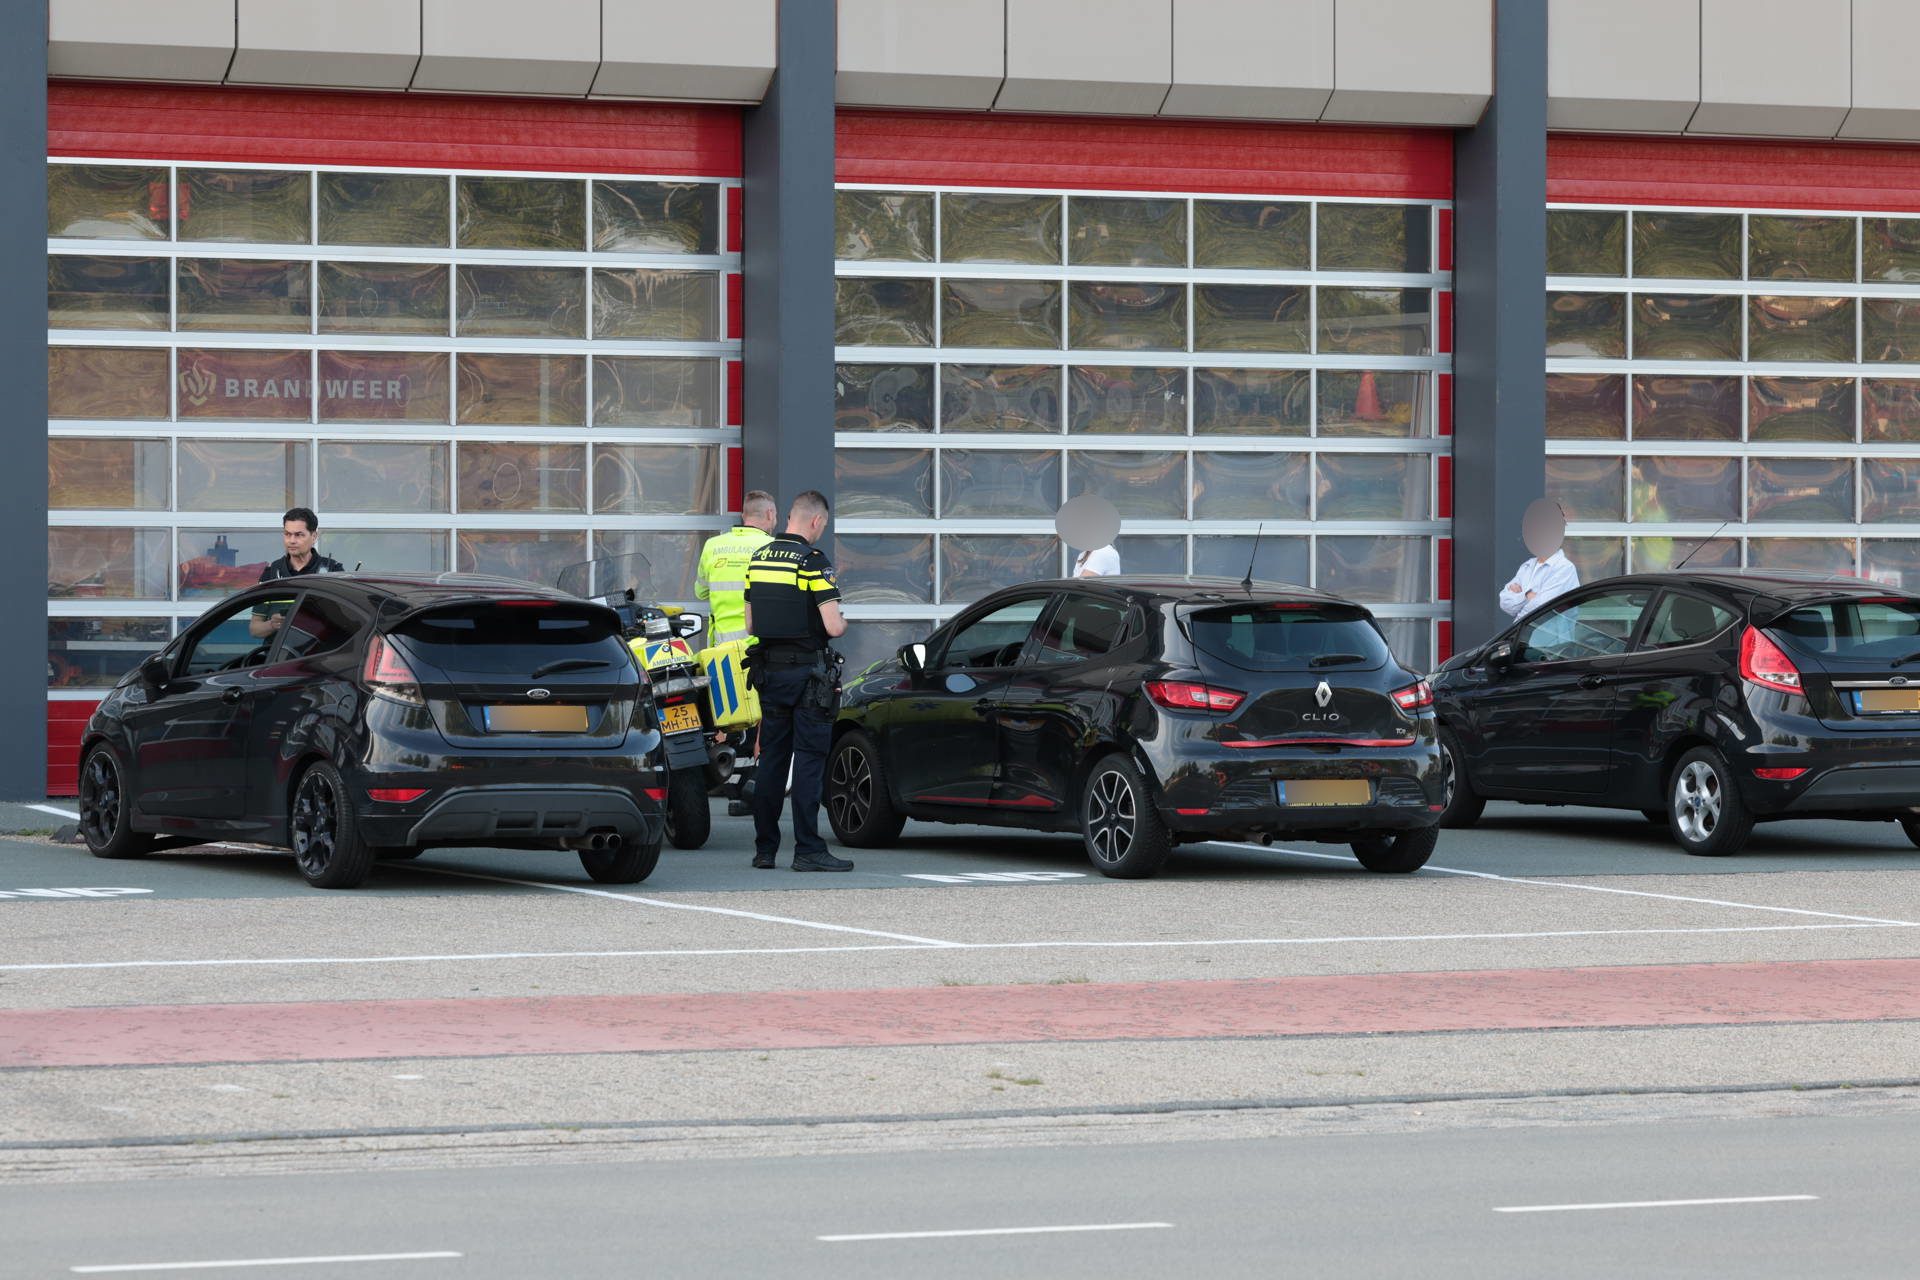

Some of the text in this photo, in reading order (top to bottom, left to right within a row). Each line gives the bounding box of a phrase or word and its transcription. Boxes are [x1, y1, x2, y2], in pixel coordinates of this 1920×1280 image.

[224, 378, 402, 399] BRANDWEER
[712, 545, 756, 556] AMBULANC
[672, 706, 688, 718] 25
[1302, 713, 1340, 721] CLIO
